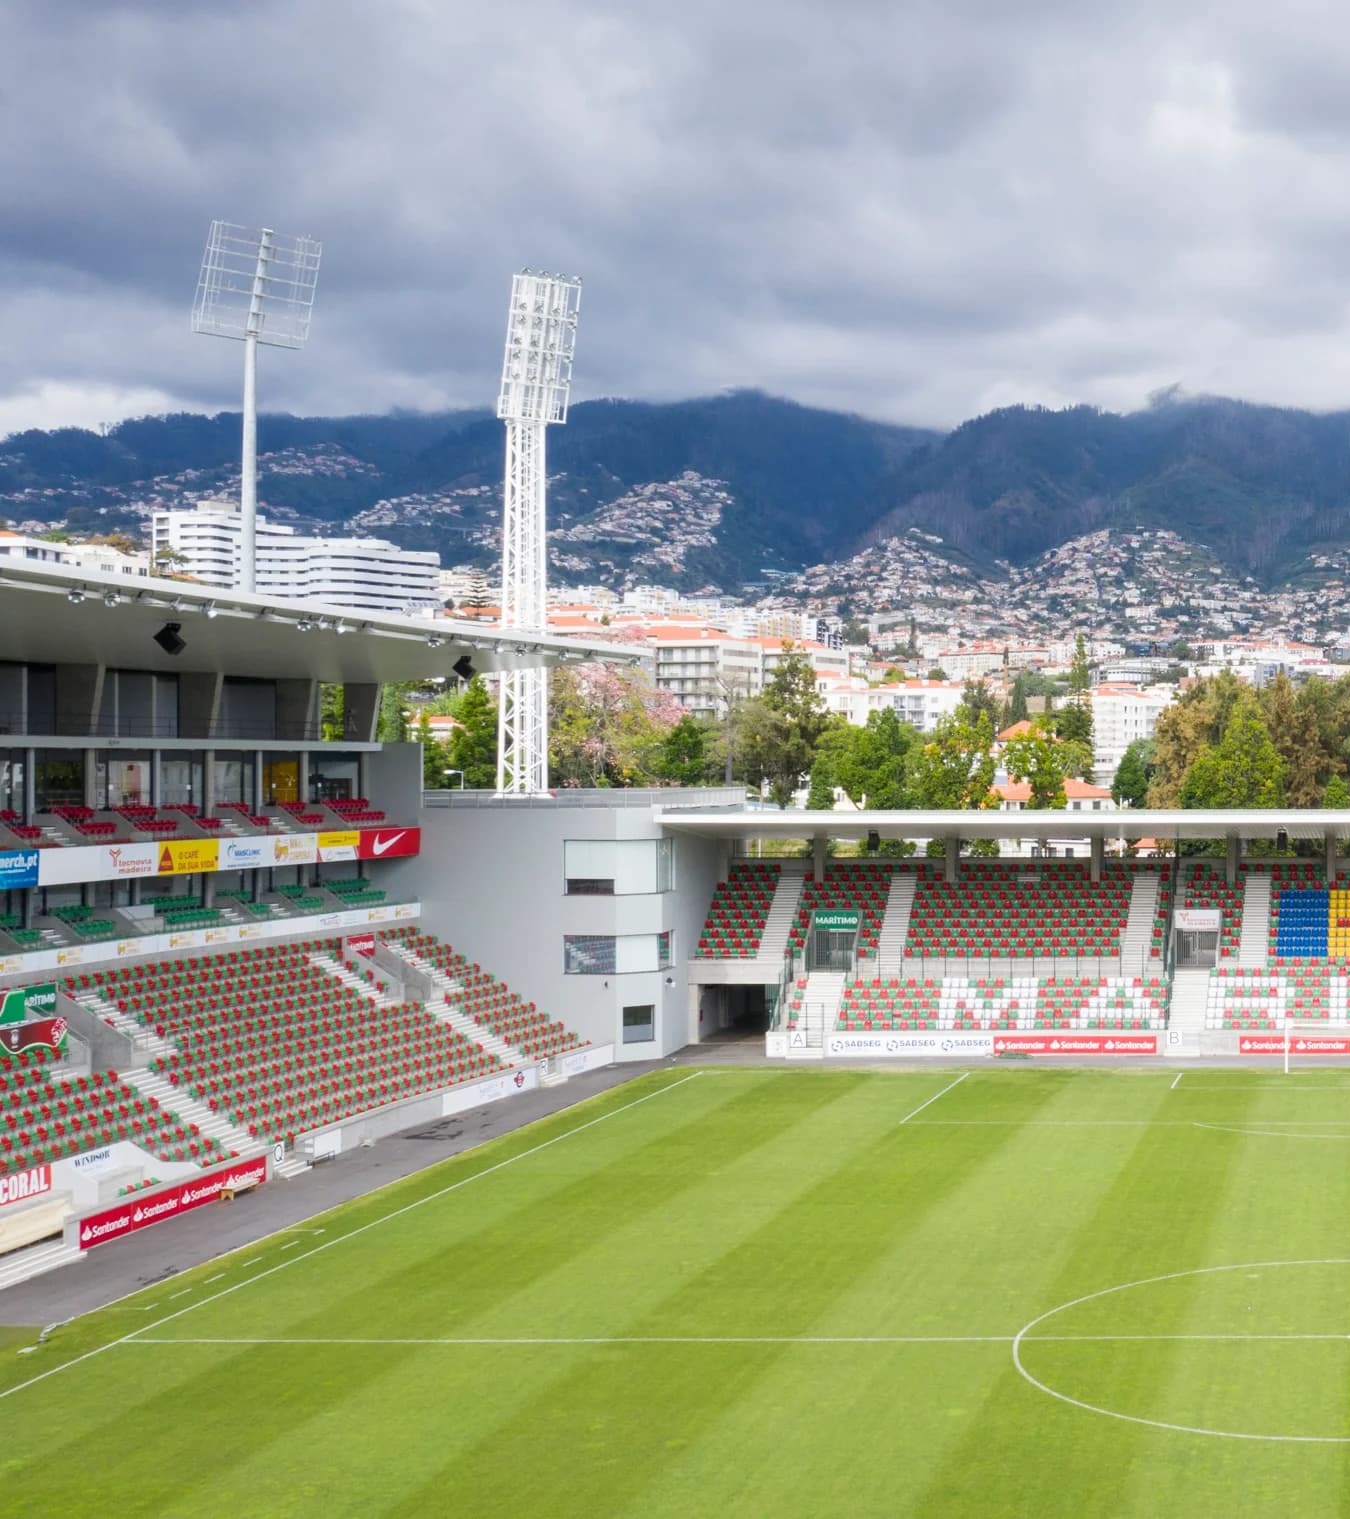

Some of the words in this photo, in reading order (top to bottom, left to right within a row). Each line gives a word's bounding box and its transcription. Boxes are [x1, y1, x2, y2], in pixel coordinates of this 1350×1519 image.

[118, 866, 152, 875] madeira
[815, 915, 858, 925] MARÍTIMO
[792, 1032, 804, 1046] A
[844, 1039, 881, 1048] SABSEG
[899, 1039, 936, 1048] SABSEG
[953, 1039, 991, 1048] SABSEG
[1169, 1032, 1179, 1044] B
[1006, 1041, 1045, 1050] Santander
[1060, 1041, 1100, 1050] Santander
[1115, 1041, 1154, 1050] Santander
[1306, 1041, 1346, 1050] Santander
[273, 1143, 284, 1162] Q
[74, 1149, 110, 1168] WINDSOR
[235, 1167, 265, 1185] Santander
[0, 1166, 49, 1204] CORAL
[190, 1182, 223, 1202] Santander
[143, 1197, 178, 1219] Santander
[92, 1214, 130, 1236] Santander
